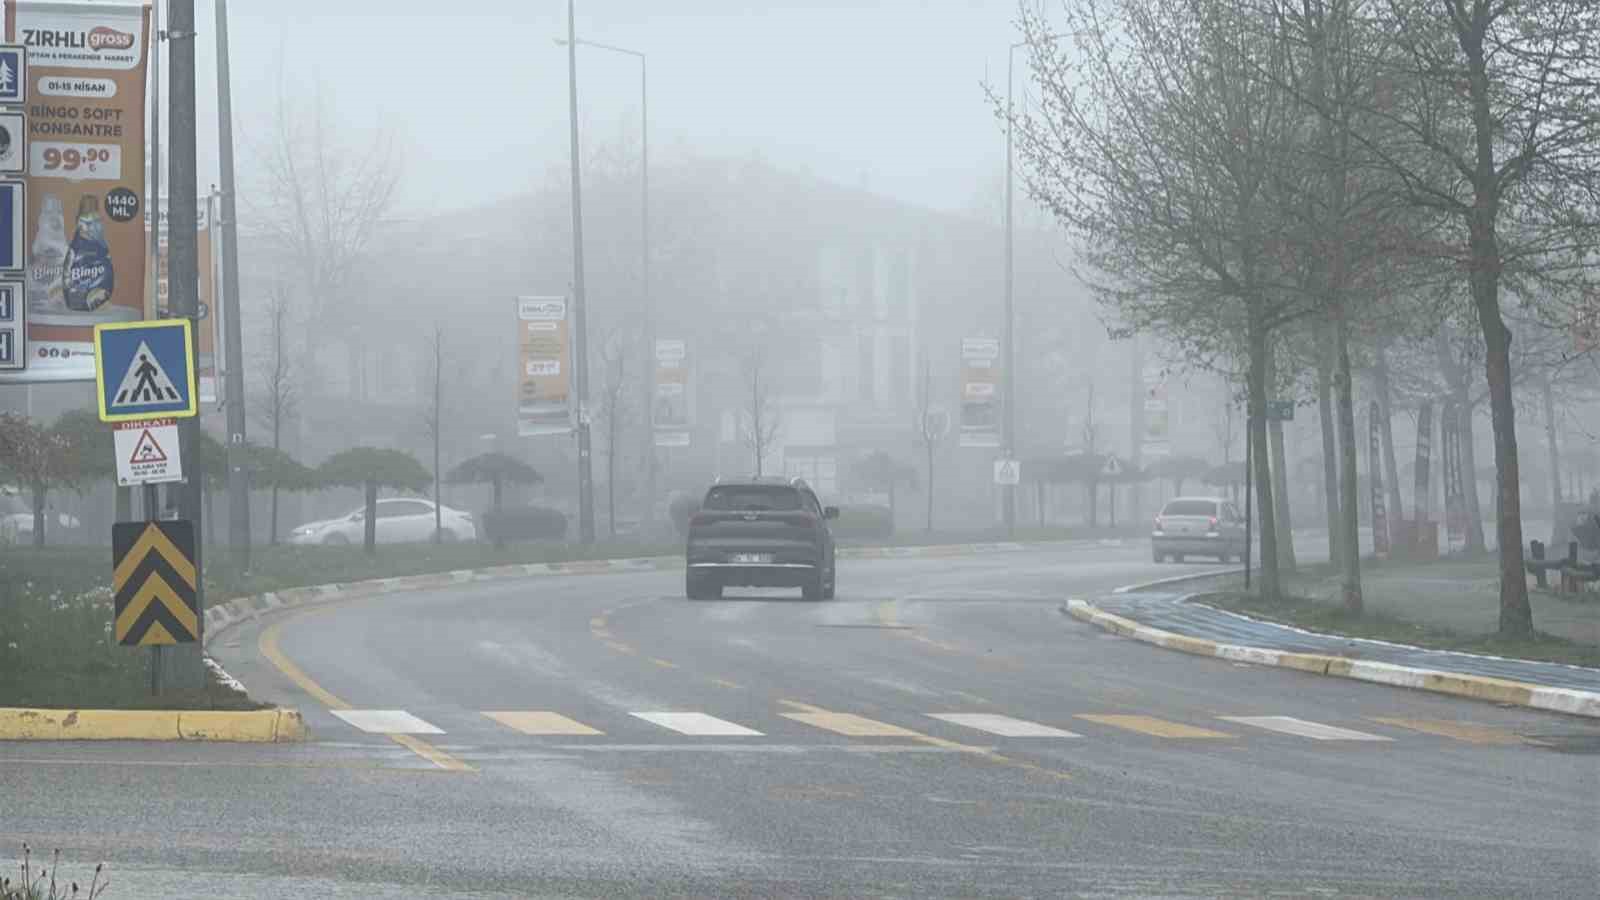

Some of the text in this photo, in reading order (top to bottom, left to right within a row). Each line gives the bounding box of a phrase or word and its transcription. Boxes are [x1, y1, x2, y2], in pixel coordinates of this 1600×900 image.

[22, 29, 130, 48] ZIRHLI gross
[48, 81, 106, 92] 01-15 NİSAN
[31, 104, 123, 121] BİNGO SOFT
[31, 122, 123, 137] KONSANTRE
[107, 195, 136, 206] 1440
[71, 264, 105, 280] Bingo
